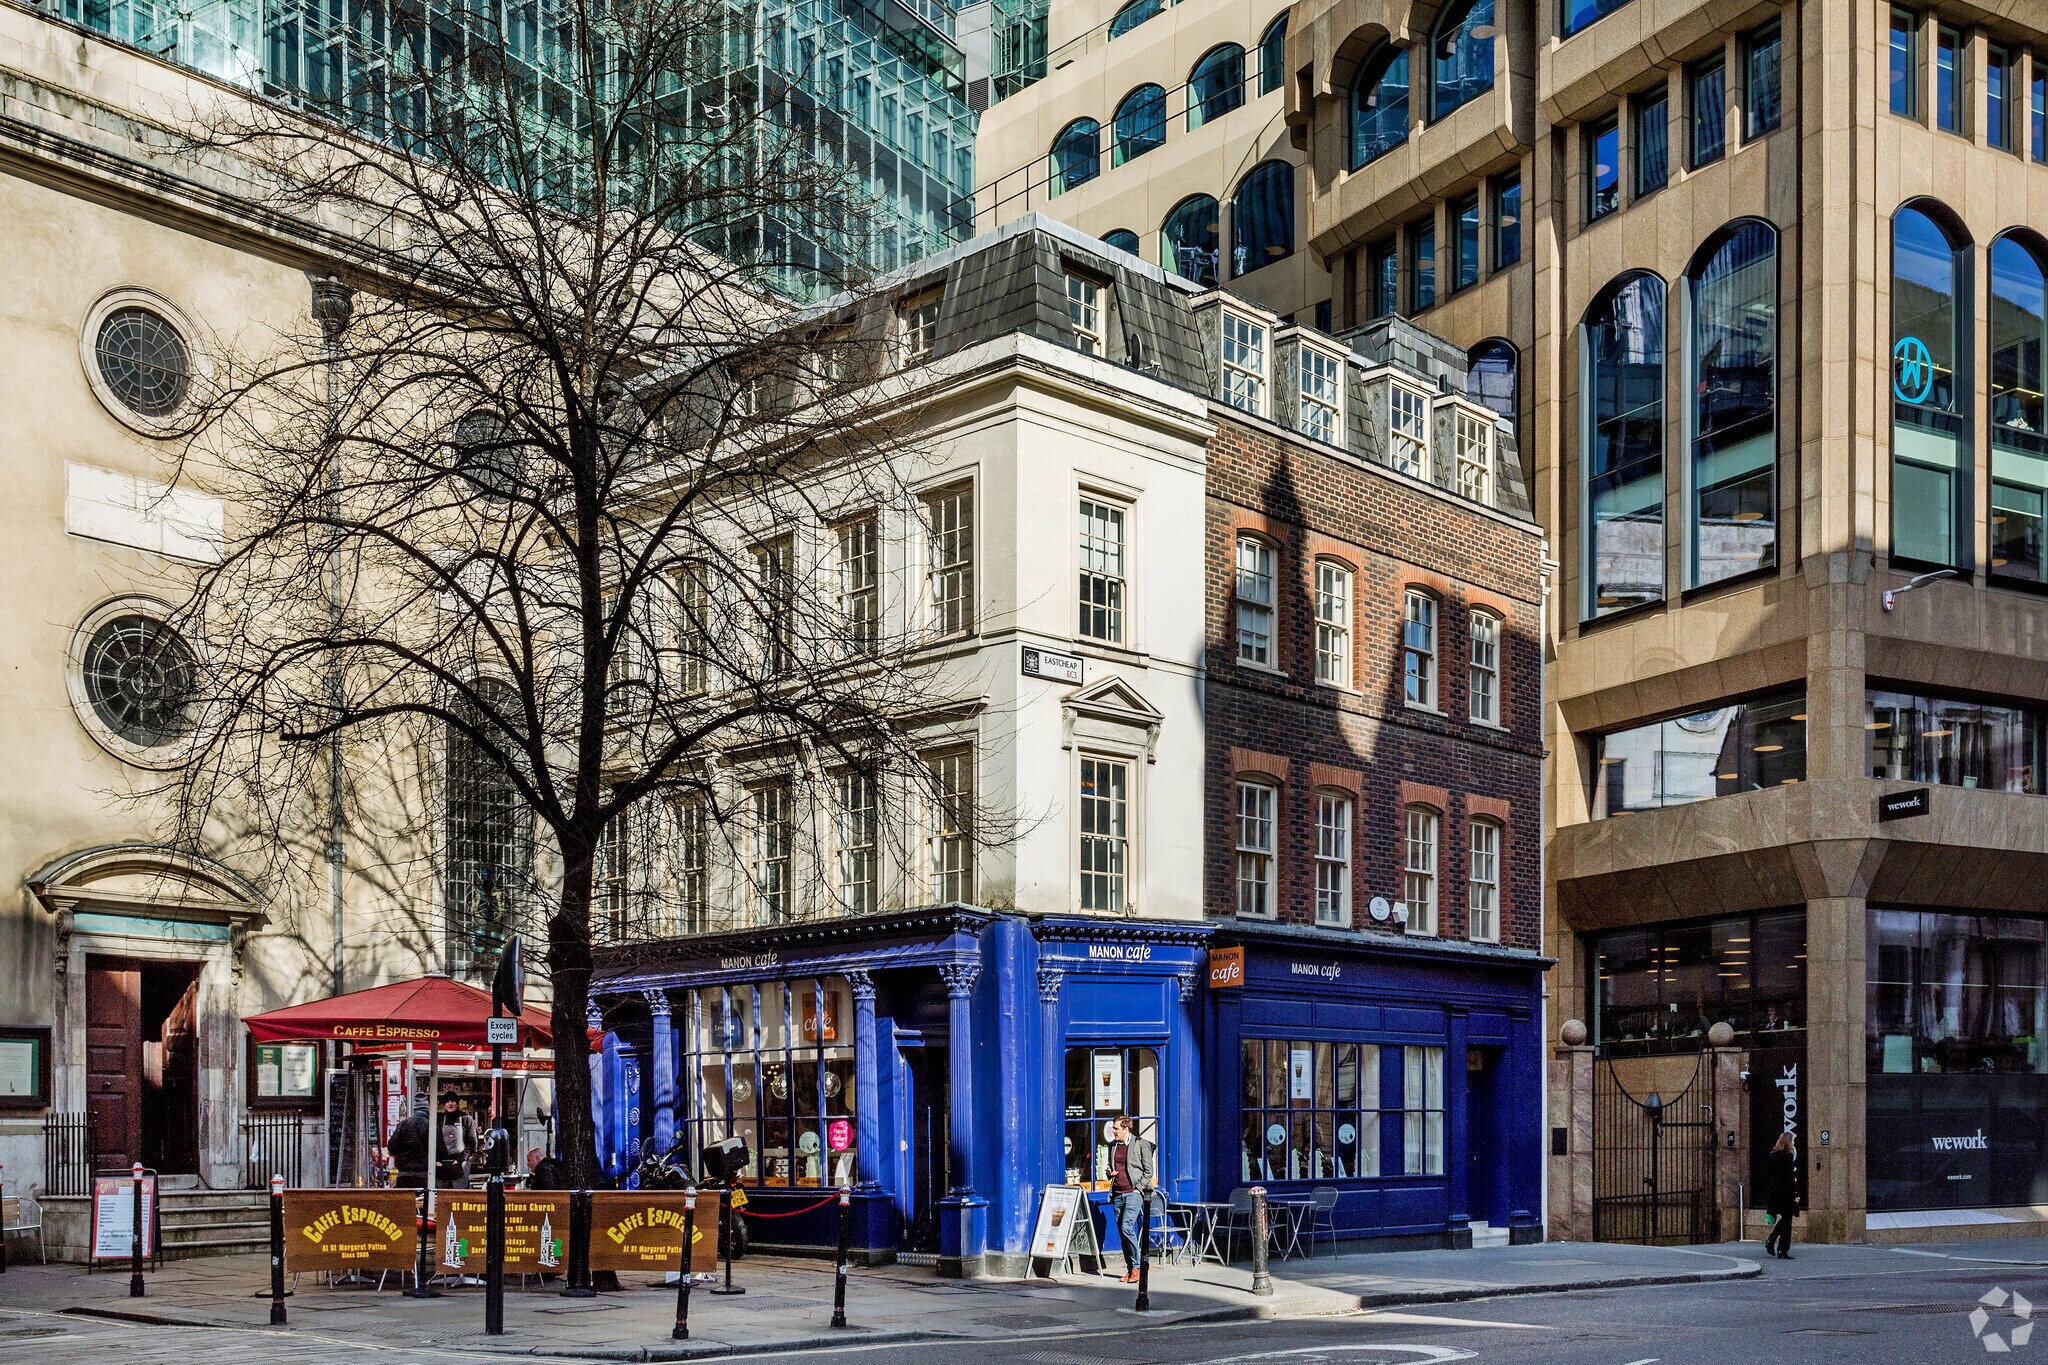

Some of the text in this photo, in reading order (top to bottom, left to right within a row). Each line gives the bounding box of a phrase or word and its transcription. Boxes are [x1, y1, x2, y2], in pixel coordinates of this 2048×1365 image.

[1044, 656, 1078, 670] EASTCHEAP
[1066, 670, 1078, 679] EC3
[1888, 796, 1920, 810] wework
[721, 949, 778, 970] MANON cafe
[1088, 944, 1150, 964] MANON cafe
[1212, 952, 1239, 962] MANON
[1212, 962, 1240, 983] cafe
[1292, 962, 1340, 980] MANON cafe
[334, 1024, 440, 1038] CAFFE ESPRESSO
[490, 1022, 514, 1030] Except
[492, 1032, 514, 1040] cycles
[1932, 1128, 1988, 1150] wework
[452, 1202, 460, 1211] St
[505, 1203, 527, 1212] attens
[529, 1203, 555, 1212] Church
[302, 1205, 403, 1243] CAFFE ESPRESSO
[607, 1212, 644, 1244] CAFFE
[339, 1244, 366, 1252] Margaret
[639, 1246, 666, 1254] Margaret
